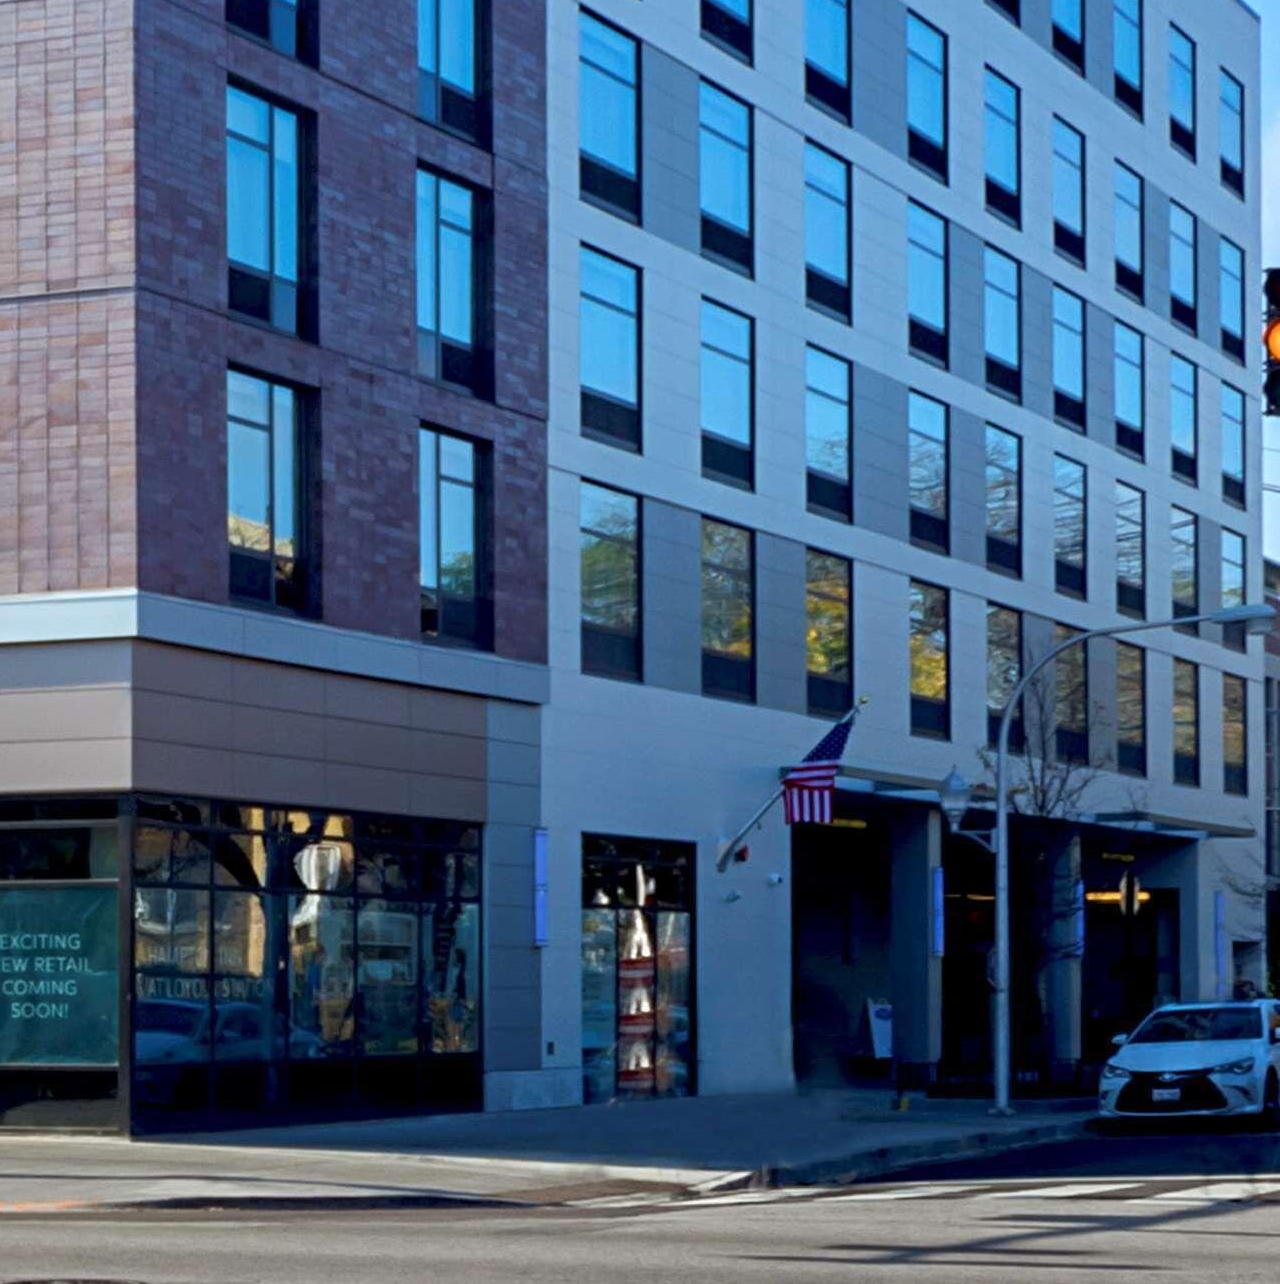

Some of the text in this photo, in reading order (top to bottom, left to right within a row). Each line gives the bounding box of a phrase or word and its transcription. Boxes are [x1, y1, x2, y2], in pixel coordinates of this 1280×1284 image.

[34, 957, 92, 972] RETAIL
[2, 979, 77, 996] COMING
[11, 1002, 68, 1018] SOON!
